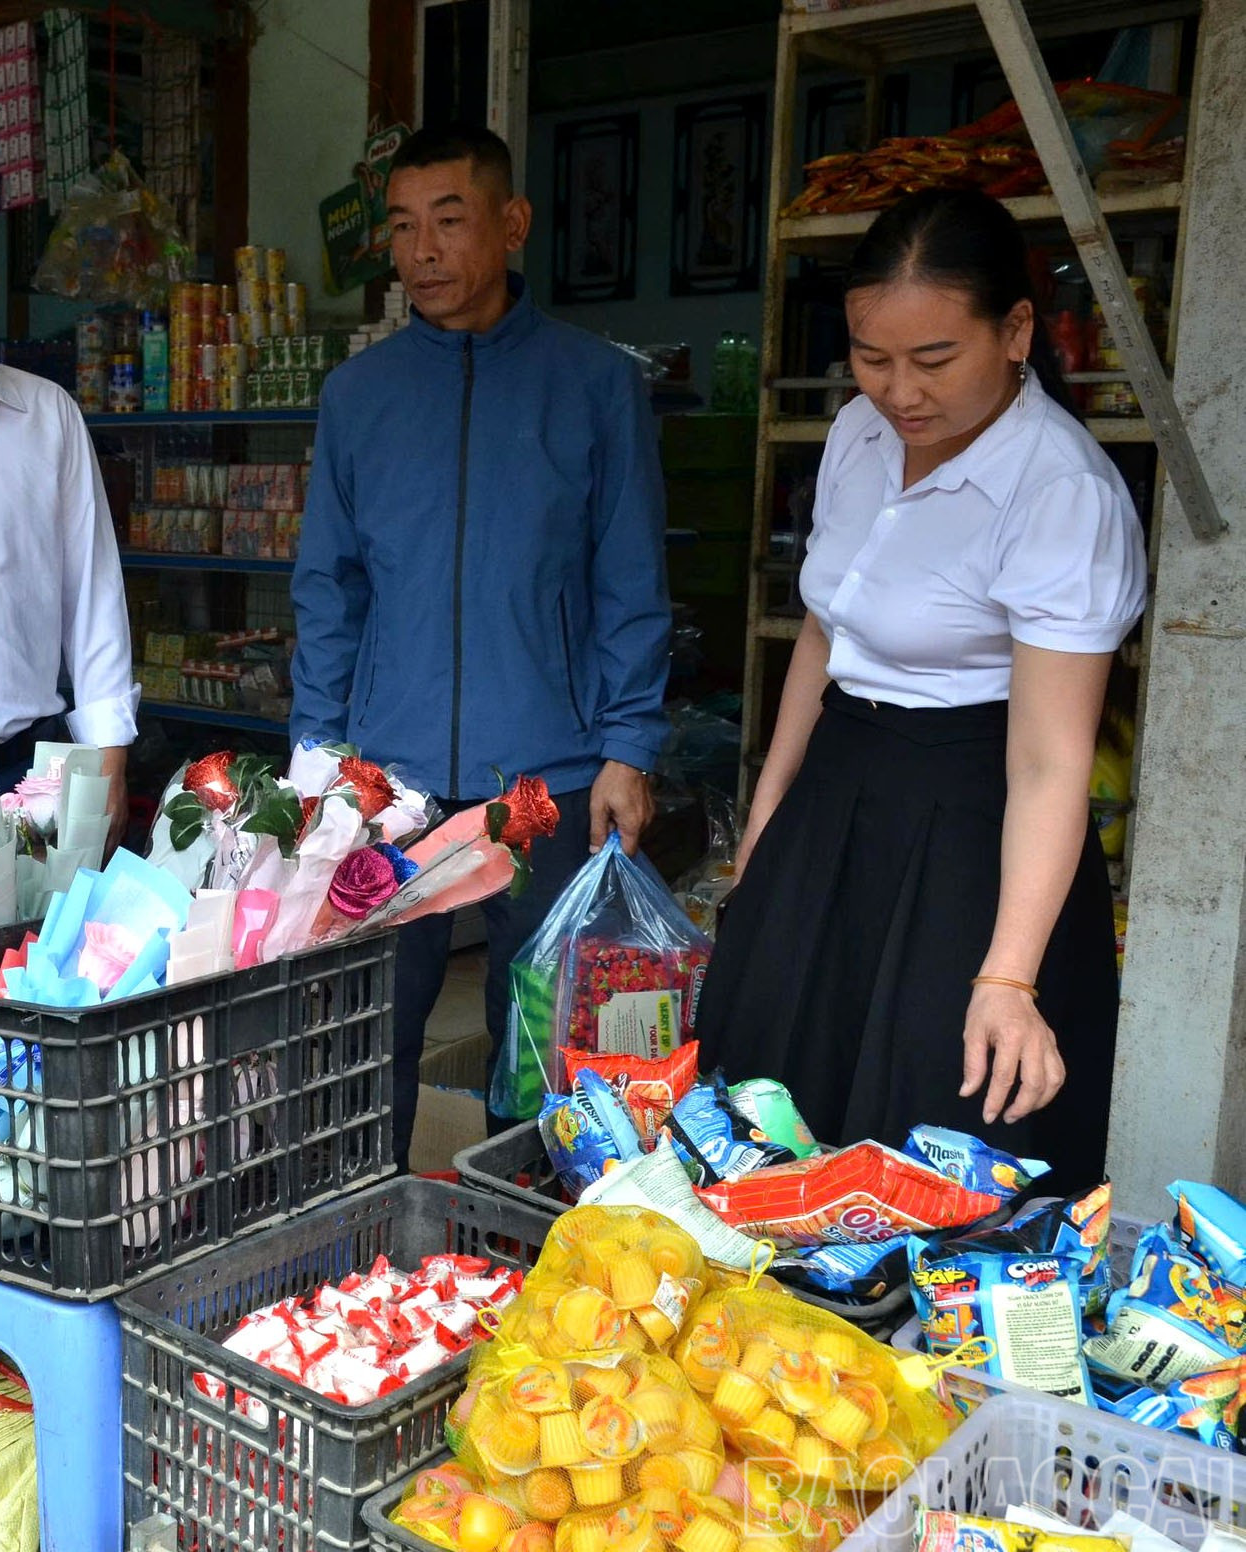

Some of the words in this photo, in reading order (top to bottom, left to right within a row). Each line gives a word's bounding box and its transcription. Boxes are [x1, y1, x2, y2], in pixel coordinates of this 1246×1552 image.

[327, 198, 362, 225] MUA
[649, 1024, 658, 1047] YOUR
[650, 1048, 659, 1059] DA
[1008, 1260, 1060, 1279] CORN
